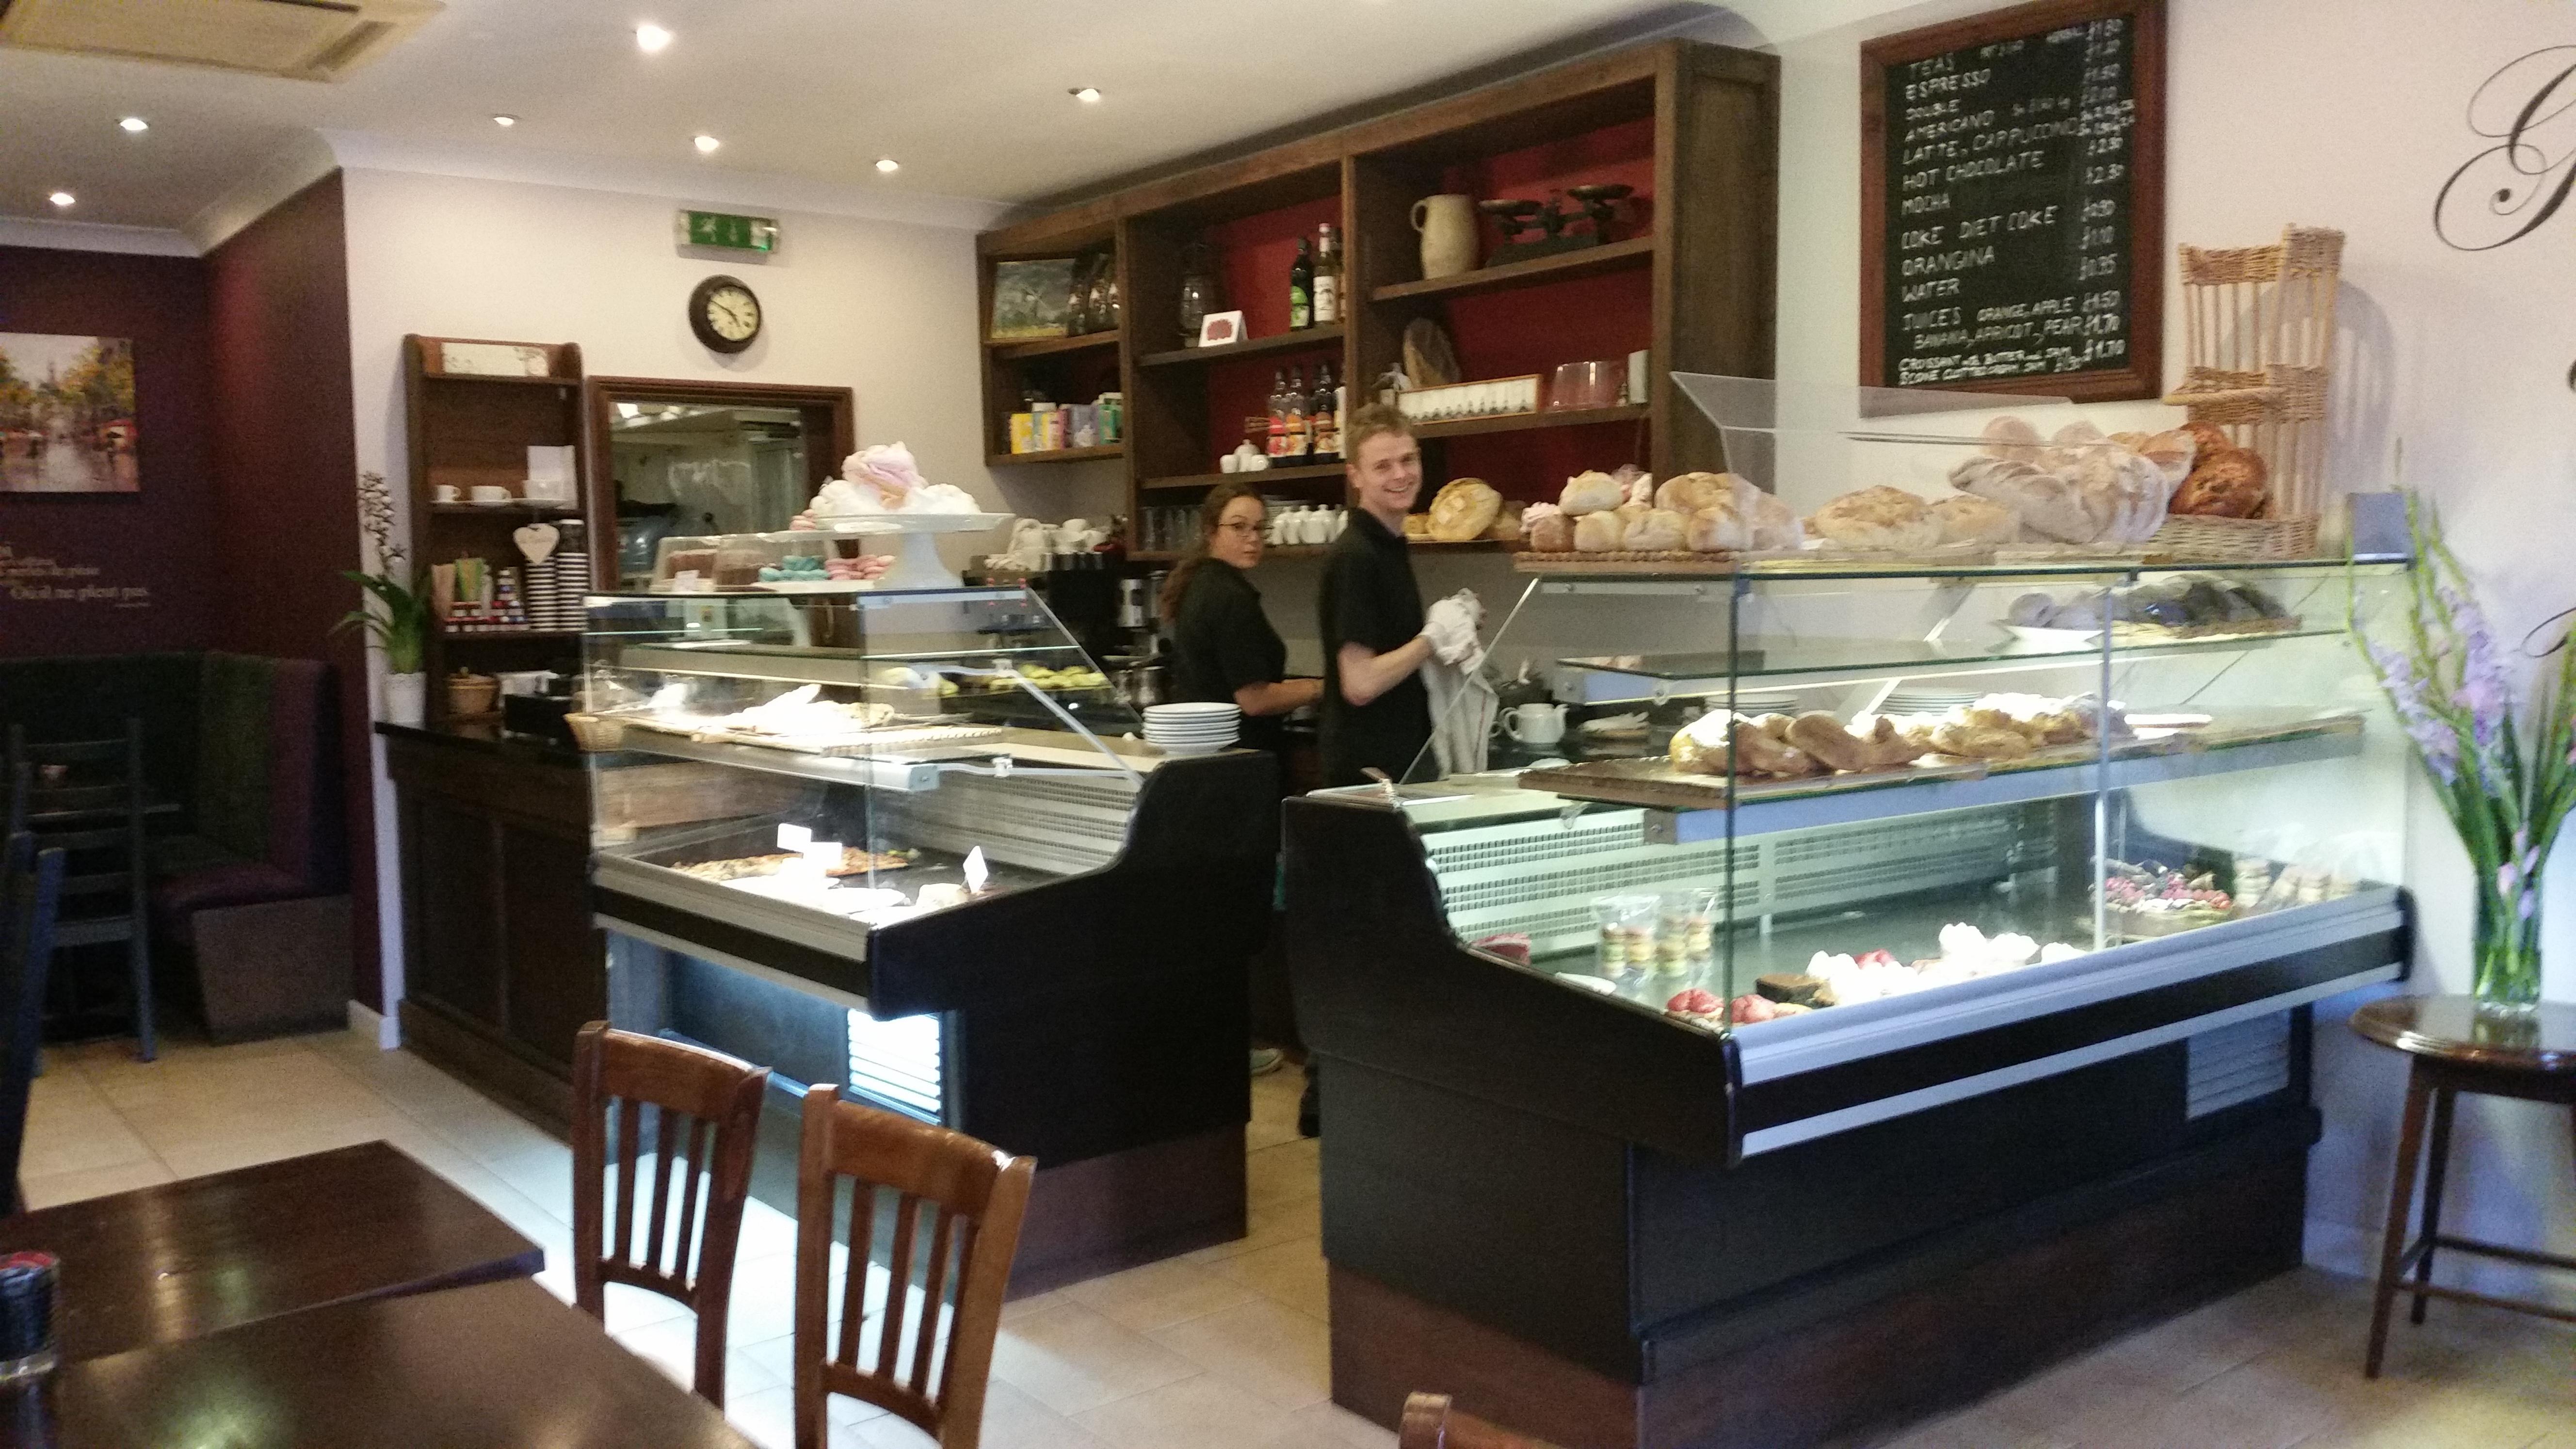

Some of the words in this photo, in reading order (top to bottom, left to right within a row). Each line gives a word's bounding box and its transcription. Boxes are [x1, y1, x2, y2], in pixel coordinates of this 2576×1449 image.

[1909, 52, 1955, 79] TEAS
[1905, 68, 1991, 100] ESPRESSO
[1904, 110, 1995, 143] AMERICANO
[1902, 168, 1940, 192] HOT
[1945, 150, 2045, 182] CHOCOLATE
[1901, 193, 1950, 215] MOCHA
[1901, 225, 1945, 250] COKE
[1958, 215, 2004, 239] DIET
[2006, 205, 2059, 231] COKE
[1901, 245, 1995, 277] ORANGINA
[1901, 277, 1960, 303] WATER
